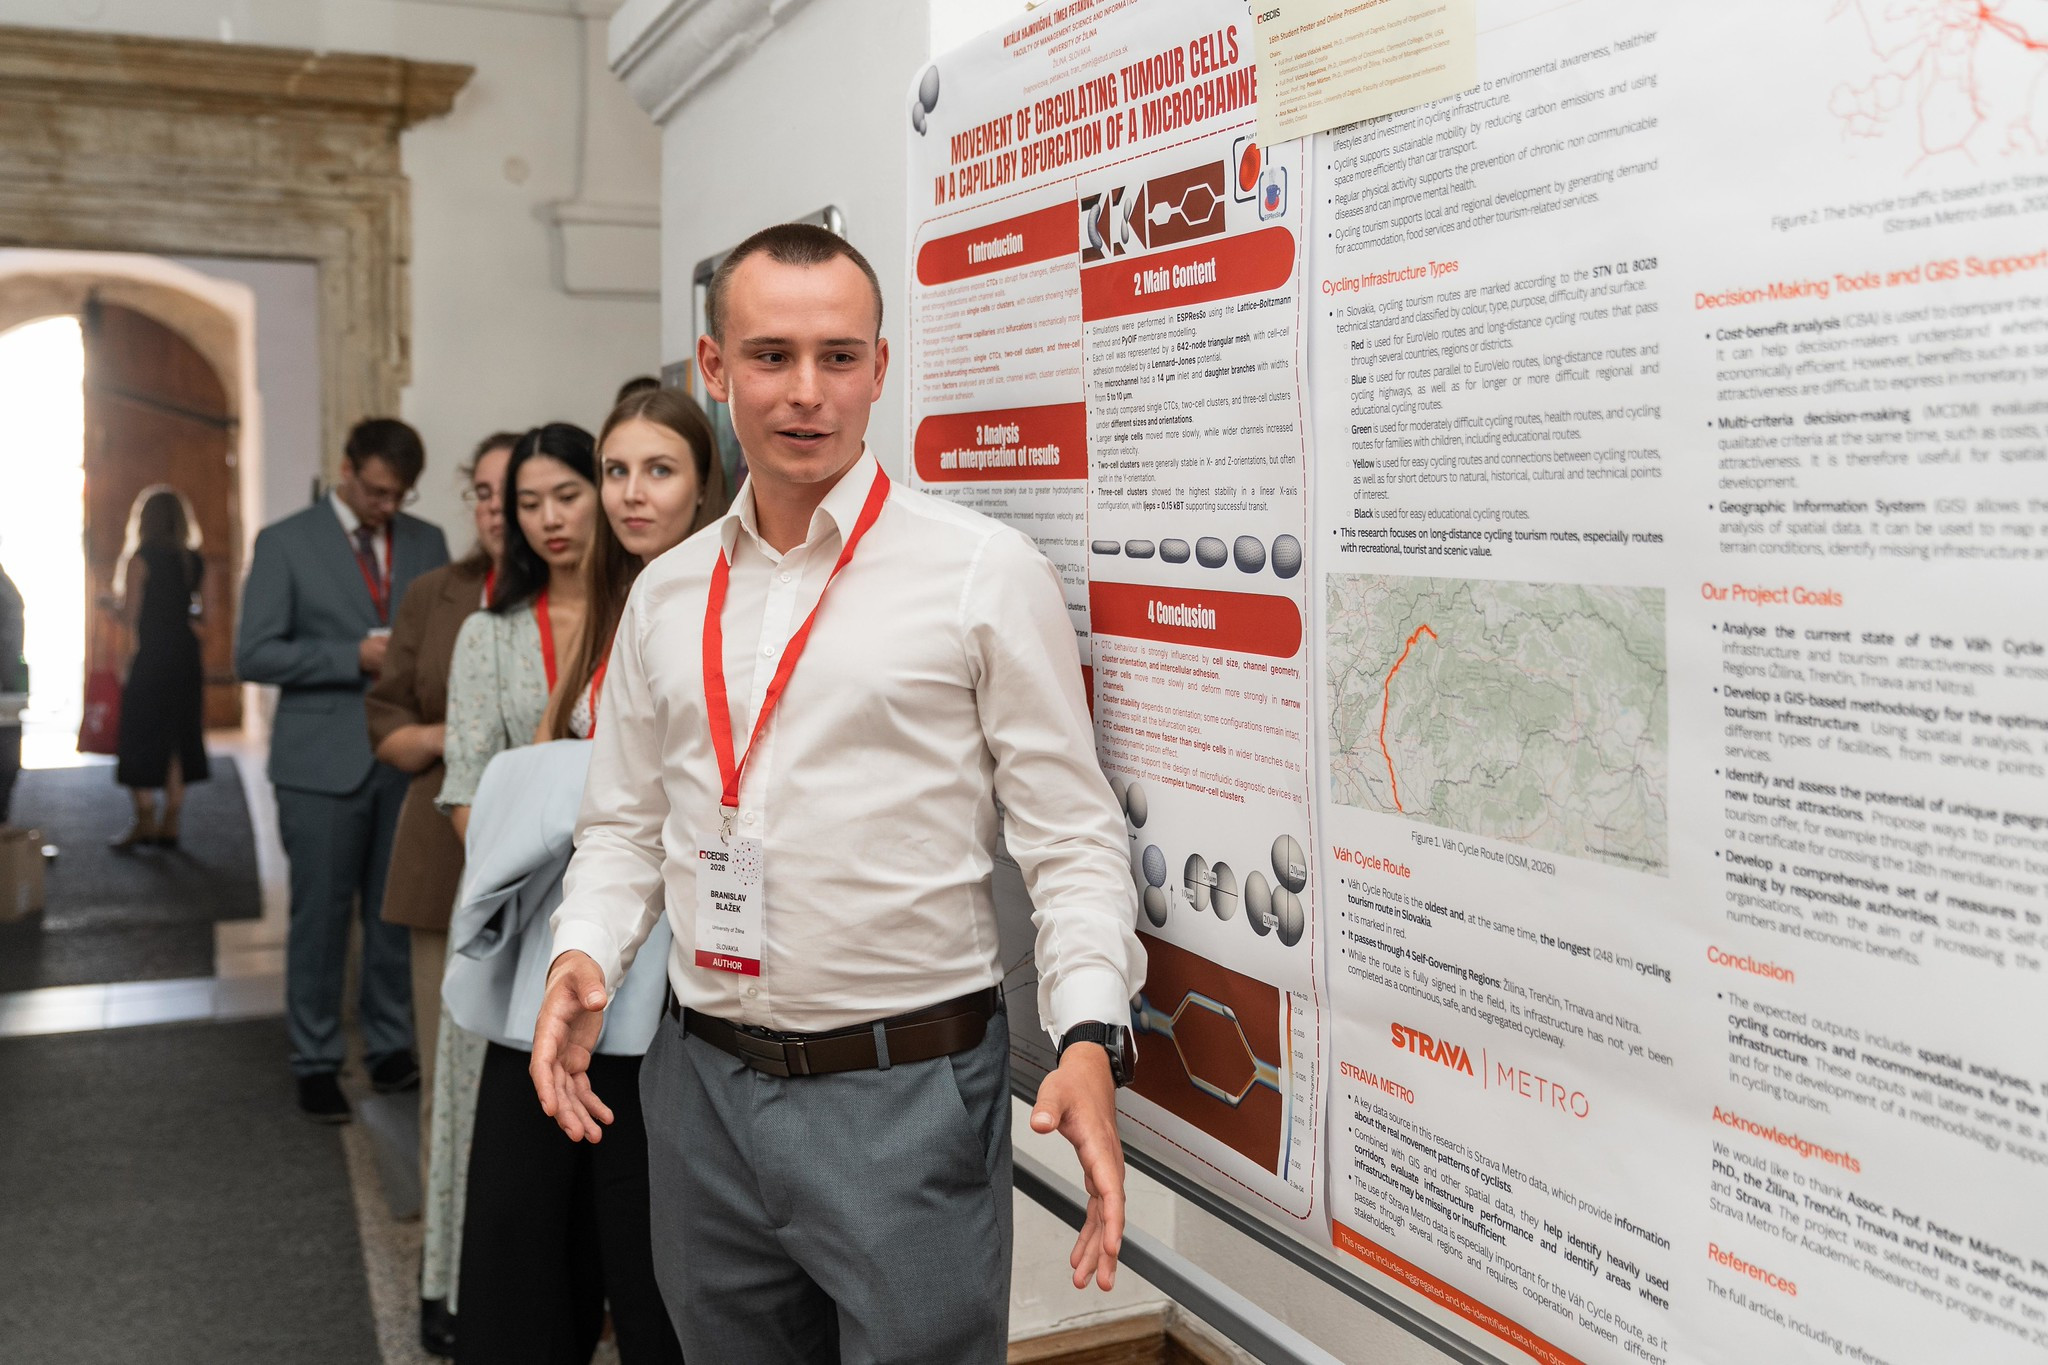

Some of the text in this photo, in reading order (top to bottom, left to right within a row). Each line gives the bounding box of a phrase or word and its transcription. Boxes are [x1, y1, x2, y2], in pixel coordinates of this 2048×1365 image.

[1269, 34, 1279, 44] 16th
[1280, 27, 1299, 40] Student
[1300, 22, 1315, 32] Poster
[1316, 17, 1325, 26] and
[1327, 12, 1342, 23] Online
[951, 25, 1238, 165] MOVEMENT OF CIRCULATING TUMOUR CELLS
[935, 64, 1257, 205] IN A CAPILLARY BIFURCATION OF A MICROCHANNE
[1334, 74, 1657, 172] Cycling supports sustainable mobility by reducing carbon emissions and using
[967, 233, 1023, 264] 1 Introduction
[1134, 258, 1216, 295] 2 Main Content
[1322, 260, 1458, 295] Cycling Infrastructure Types
[1695, 249, 2047, 309] Decision-Making Tools and GIS Support
[1092, 324, 1119, 335] Simulations
[1122, 322, 1134, 330] were
[1137, 316, 1165, 329] performed
[1177, 310, 1206, 322] ESPResSo
[1209, 307, 1222, 317] using
[1225, 305, 1234, 314] the
[1716, 317, 1840, 341] Cost-benefit analysis
[1803, 409, 1910, 425] decision-making
[976, 422, 1019, 448] 3 Analysis
[940, 444, 1059, 470] and interpretation of results
[1719, 499, 1925, 516] Geographic Information System
[1340, 527, 1355, 537] This
[1357, 527, 1387, 537] research
[1389, 527, 1416, 538] focuses
[1418, 530, 1427, 538] on
[1430, 528, 1481, 541] long-distance
[1483, 528, 1512, 542] cycling
[1514, 529, 1547, 540] tourism
[1582, 530, 1628, 545] especially
[1632, 532, 1663, 542] routes
[1701, 583, 1842, 606] Our Project Goals
[1148, 600, 1215, 629] 4 Conclusion
[1161, 776, 1184, 787] complex
[1185, 781, 1218, 796] tumour-cell
[710, 863, 725, 871] 2026
[1333, 846, 1410, 878] Váh Cycle Route
[1411, 830, 1433, 845] Figure
[1442, 838, 1456, 850] Váh
[1457, 842, 1478, 856] Cycle
[1480, 847, 1503, 862] Route
[1531, 859, 1555, 875] 2026)
[710, 890, 746, 901] BRANISLAV
[716, 902, 740, 912] BLAŽEK
[716, 943, 738, 952] SLOVAKIA
[712, 958, 742, 970] AUTHOR
[1348, 930, 1353, 940] It
[1354, 934, 1376, 947] passes
[1377, 940, 1404, 958] through
[1405, 949, 1410, 958] 4
[1411, 950, 1467, 980] Self-Governing
[1564, 999, 1594, 1019] Trnava
[1595, 1011, 1613, 1025] and
[1707, 945, 1794, 983] Conclusion
[1340, 1061, 1414, 1104] STRAVA METRO
[1391, 1022, 1588, 1117] STRAVA METRO
[1354, 1111, 1374, 1126] about
[1375, 1119, 1386, 1132] the
[1387, 1127, 1399, 1139] real
[1400, 1133, 1436, 1158] movement
[1438, 1152, 1469, 1173] patterns
[1471, 1167, 1479, 1178] of
[1712, 1105, 1860, 1173] Acknowledgments
[1708, 1242, 1796, 1296] References
[1340, 1232, 1550, 1361] This report includes aggregated and de-identified data from
